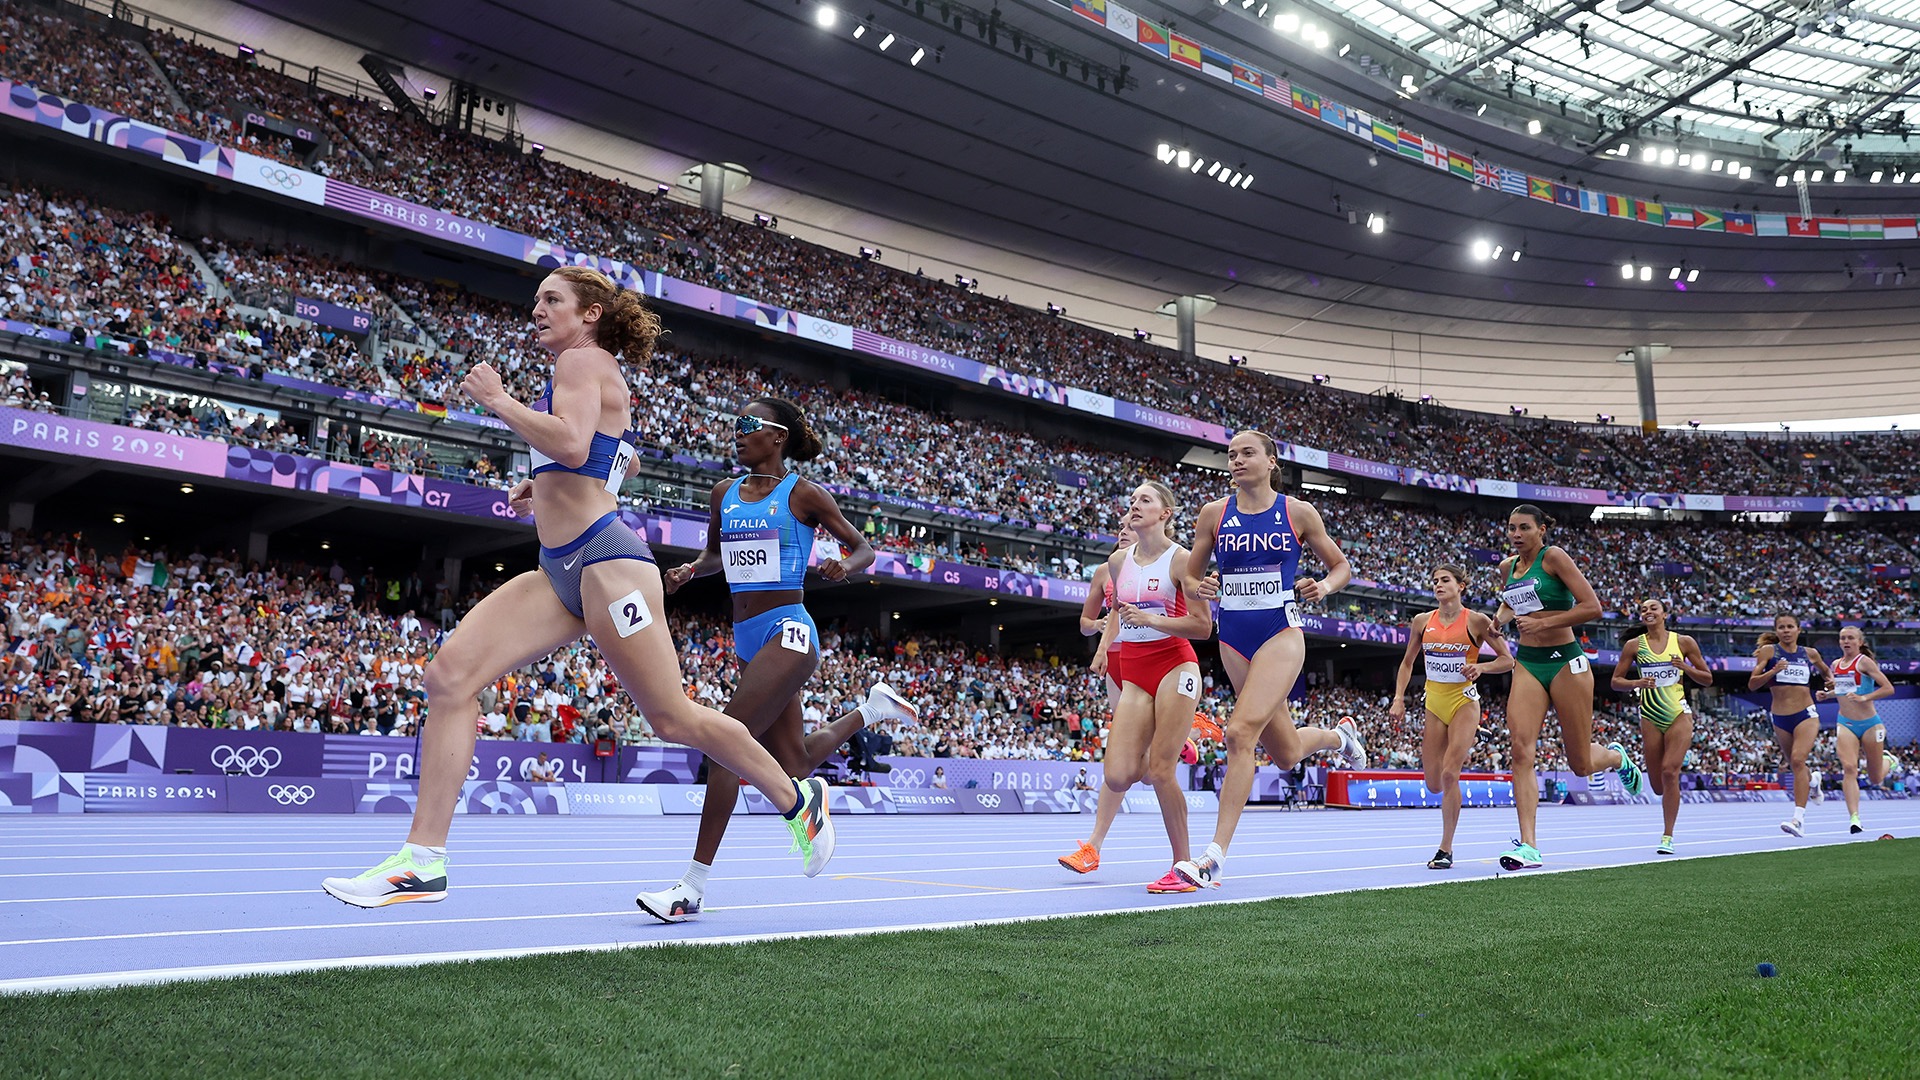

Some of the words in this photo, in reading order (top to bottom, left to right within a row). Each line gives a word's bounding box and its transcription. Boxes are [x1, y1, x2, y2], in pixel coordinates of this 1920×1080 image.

[247, 113, 266, 126] G2
[370, 198, 428, 226] PARIS
[435, 218, 486, 242] 2024
[353, 315, 370, 329] E9
[880, 342, 918, 360] PARIS
[922, 352, 955, 371] 2024
[1135, 409, 1164, 426] PARIS
[1166, 417, 1192, 431] 2024
[12, 418, 100, 448] PARIS
[112, 435, 185, 461] 2024
[1344, 460, 1369, 473] PARIS
[1371, 465, 1394, 477] 2024
[425, 490, 451, 508] G7
[1535, 488, 1561, 498] PARIS
[1564, 491, 1589, 500] 2024
[1743, 500, 1773, 508] PARIS
[729, 519, 768, 529] ITALIA
[1218, 533, 1292, 553] FRANCE
[729, 549, 767, 566] VISSA
[944, 570, 960, 584] G5
[984, 576, 998, 589] D5
[1064, 585, 1090, 598] PARI
[1224, 581, 1280, 597] GUILLEMOT
[623, 602, 643, 627] 2
[787, 626, 806, 647] 14
[1576, 657, 1582, 669] 1
[1643, 670, 1678, 679] TRACEY
[1784, 669, 1804, 677] BREA
[1186, 678, 1195, 692] 8
[993, 771, 1052, 790] PARIS
[98, 786, 157, 798] PARIS
[165, 786, 216, 799] 2024
[575, 793, 615, 804] PARIS
[618, 794, 654, 804] 2024
[899, 795, 927, 804] PARIS
[929, 795, 956, 804] 2024
[1367, 787, 1377, 800] 10
[1395, 787, 1401, 799] 9
[1420, 787, 1426, 799] 8
[1466, 787, 1472, 798] 6
[1487, 787, 1493, 798] 5
[1508, 787, 1514, 798] 4
